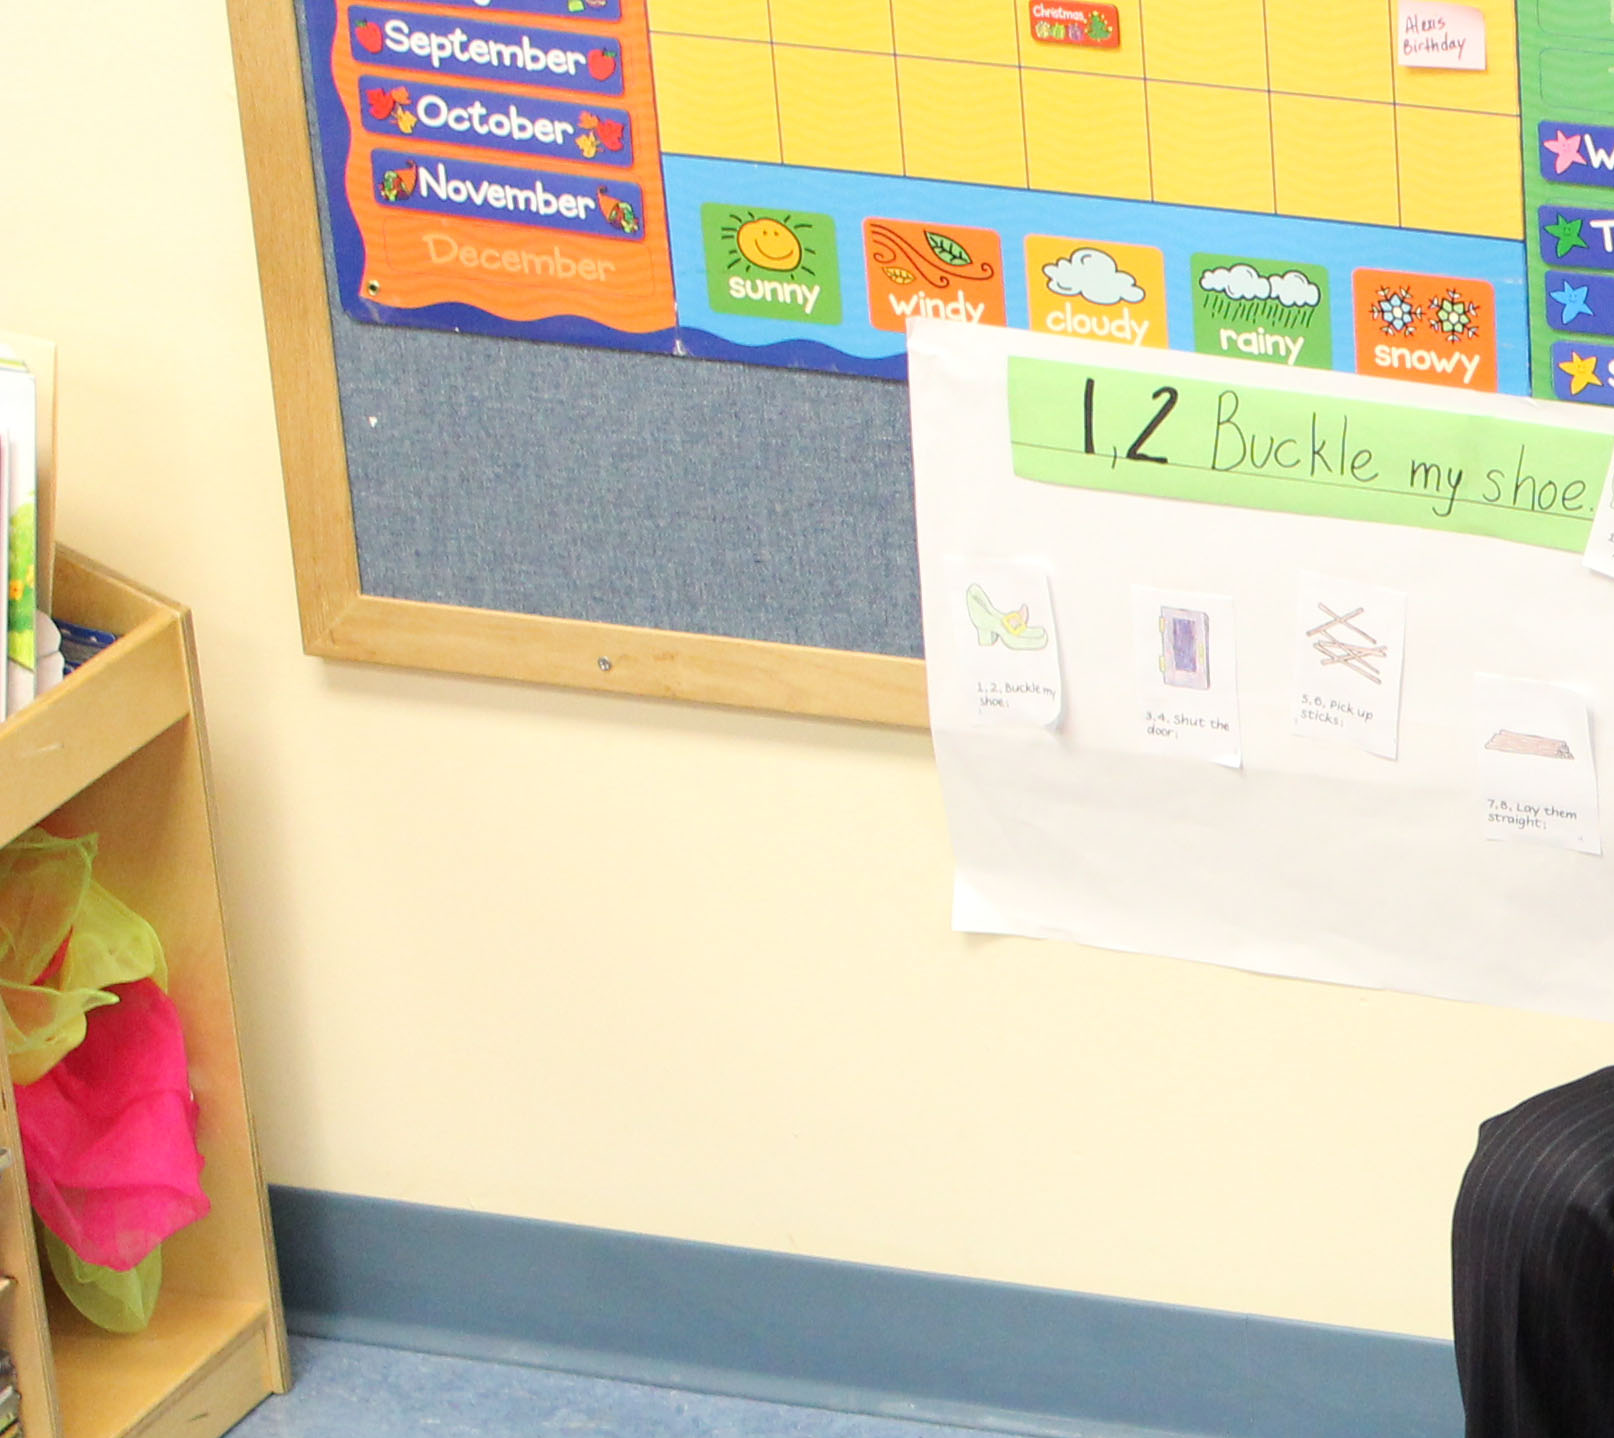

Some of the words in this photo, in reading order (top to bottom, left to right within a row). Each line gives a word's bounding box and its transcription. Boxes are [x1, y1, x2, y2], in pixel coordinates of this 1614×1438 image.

[1032, 3, 1086, 21] Christmas
[1405, 14, 1446, 34] Alexis
[384, 19, 587, 76] September
[1403, 31, 1467, 61] Birthday
[415, 94, 575, 146] October
[417, 165, 597, 221] November
[423, 232, 616, 283] December
[728, 275, 822, 314] sunny
[889, 291, 985, 324] windy
[1045, 305, 1150, 346] cloudy
[1219, 323, 1306, 366] rainy
[1374, 340, 1481, 384] snowy
[1212, 390, 1379, 483] Buckle
[1410, 457, 1463, 518] my
[1005, 681, 1041, 695] Buckle
[1173, 712, 1206, 729] Shut
[1210, 716, 1230, 732] the
[1357, 708, 1374, 724] up
[1516, 802, 1540, 818] Lay
[1543, 805, 1577, 821] them
